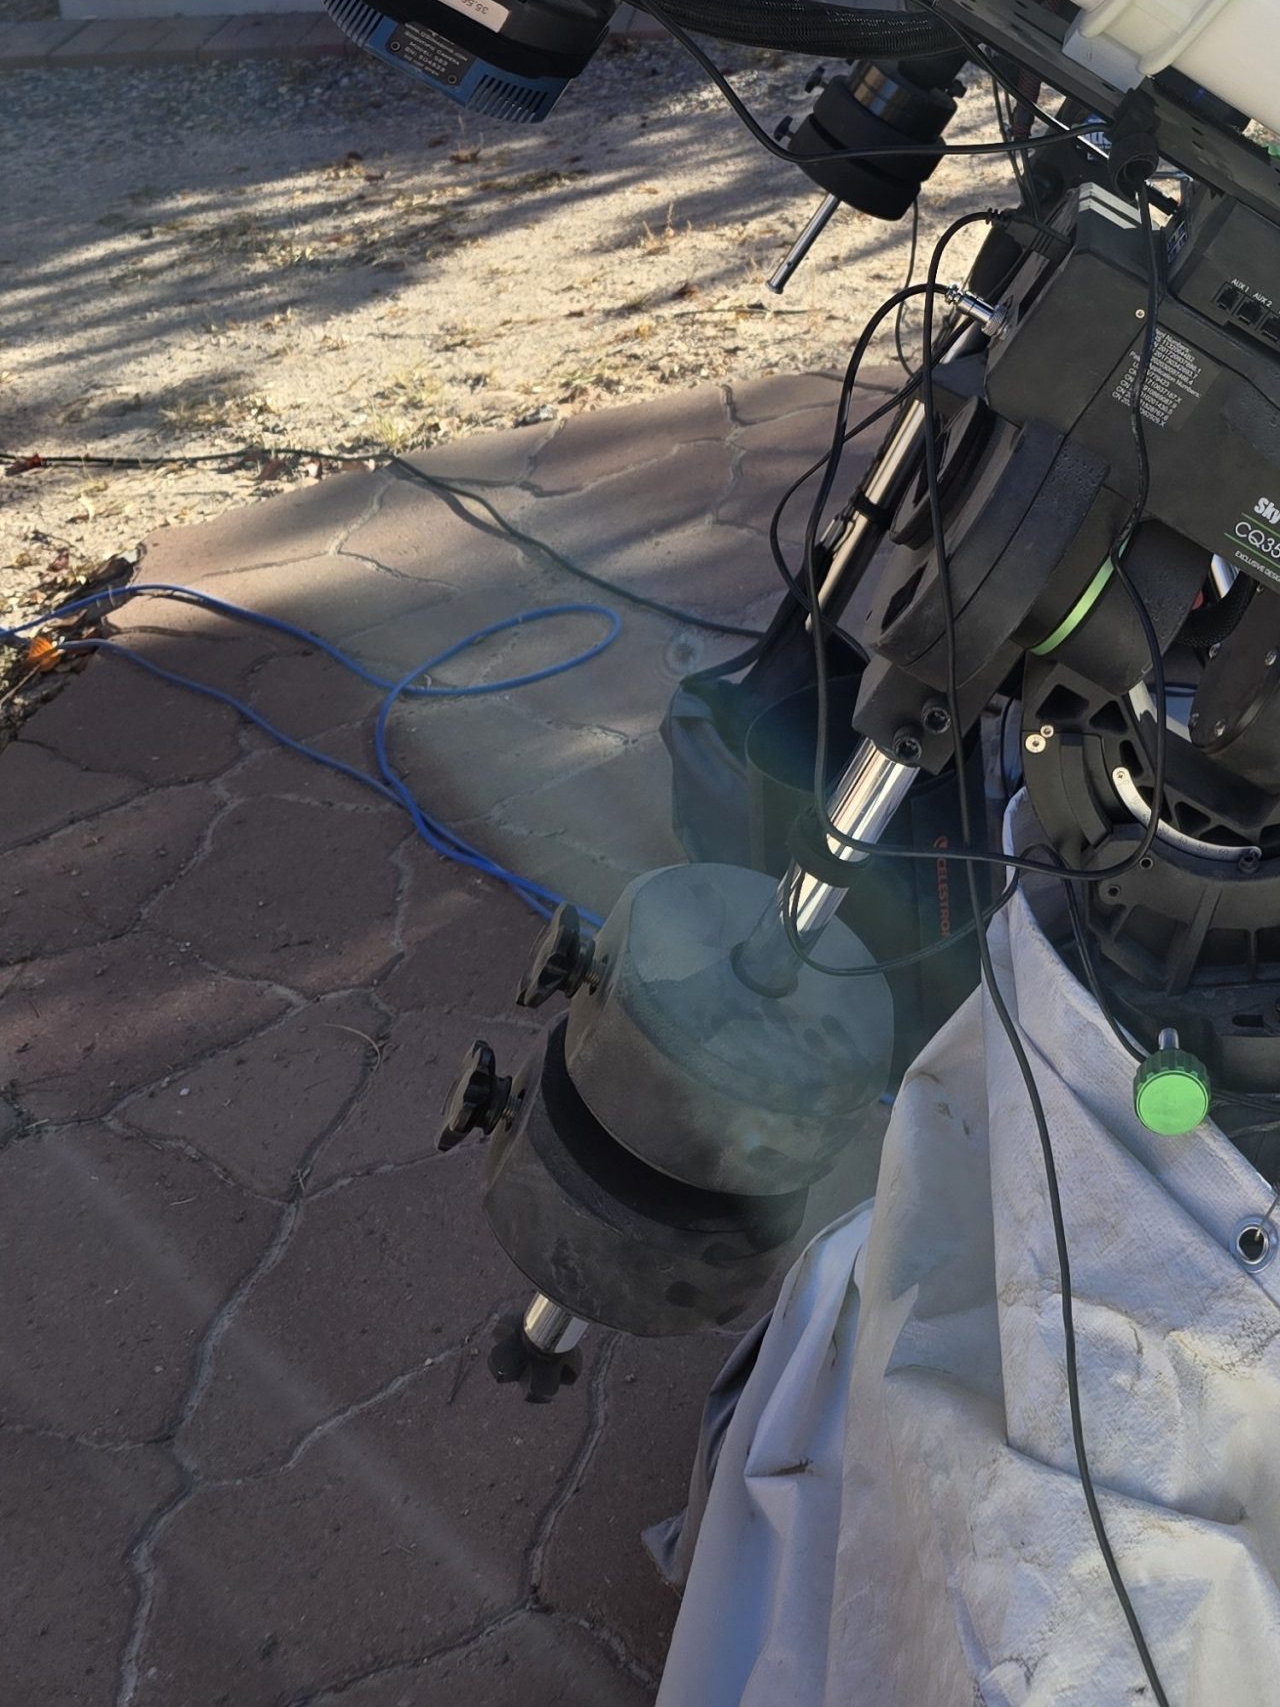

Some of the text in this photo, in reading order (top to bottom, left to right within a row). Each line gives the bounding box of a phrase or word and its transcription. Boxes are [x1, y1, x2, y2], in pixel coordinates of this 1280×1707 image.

[1230, 277, 1245, 290] AUX
[1251, 290, 1267, 305] AUX
[1233, 549, 1265, 573] EXCLUSIVE
